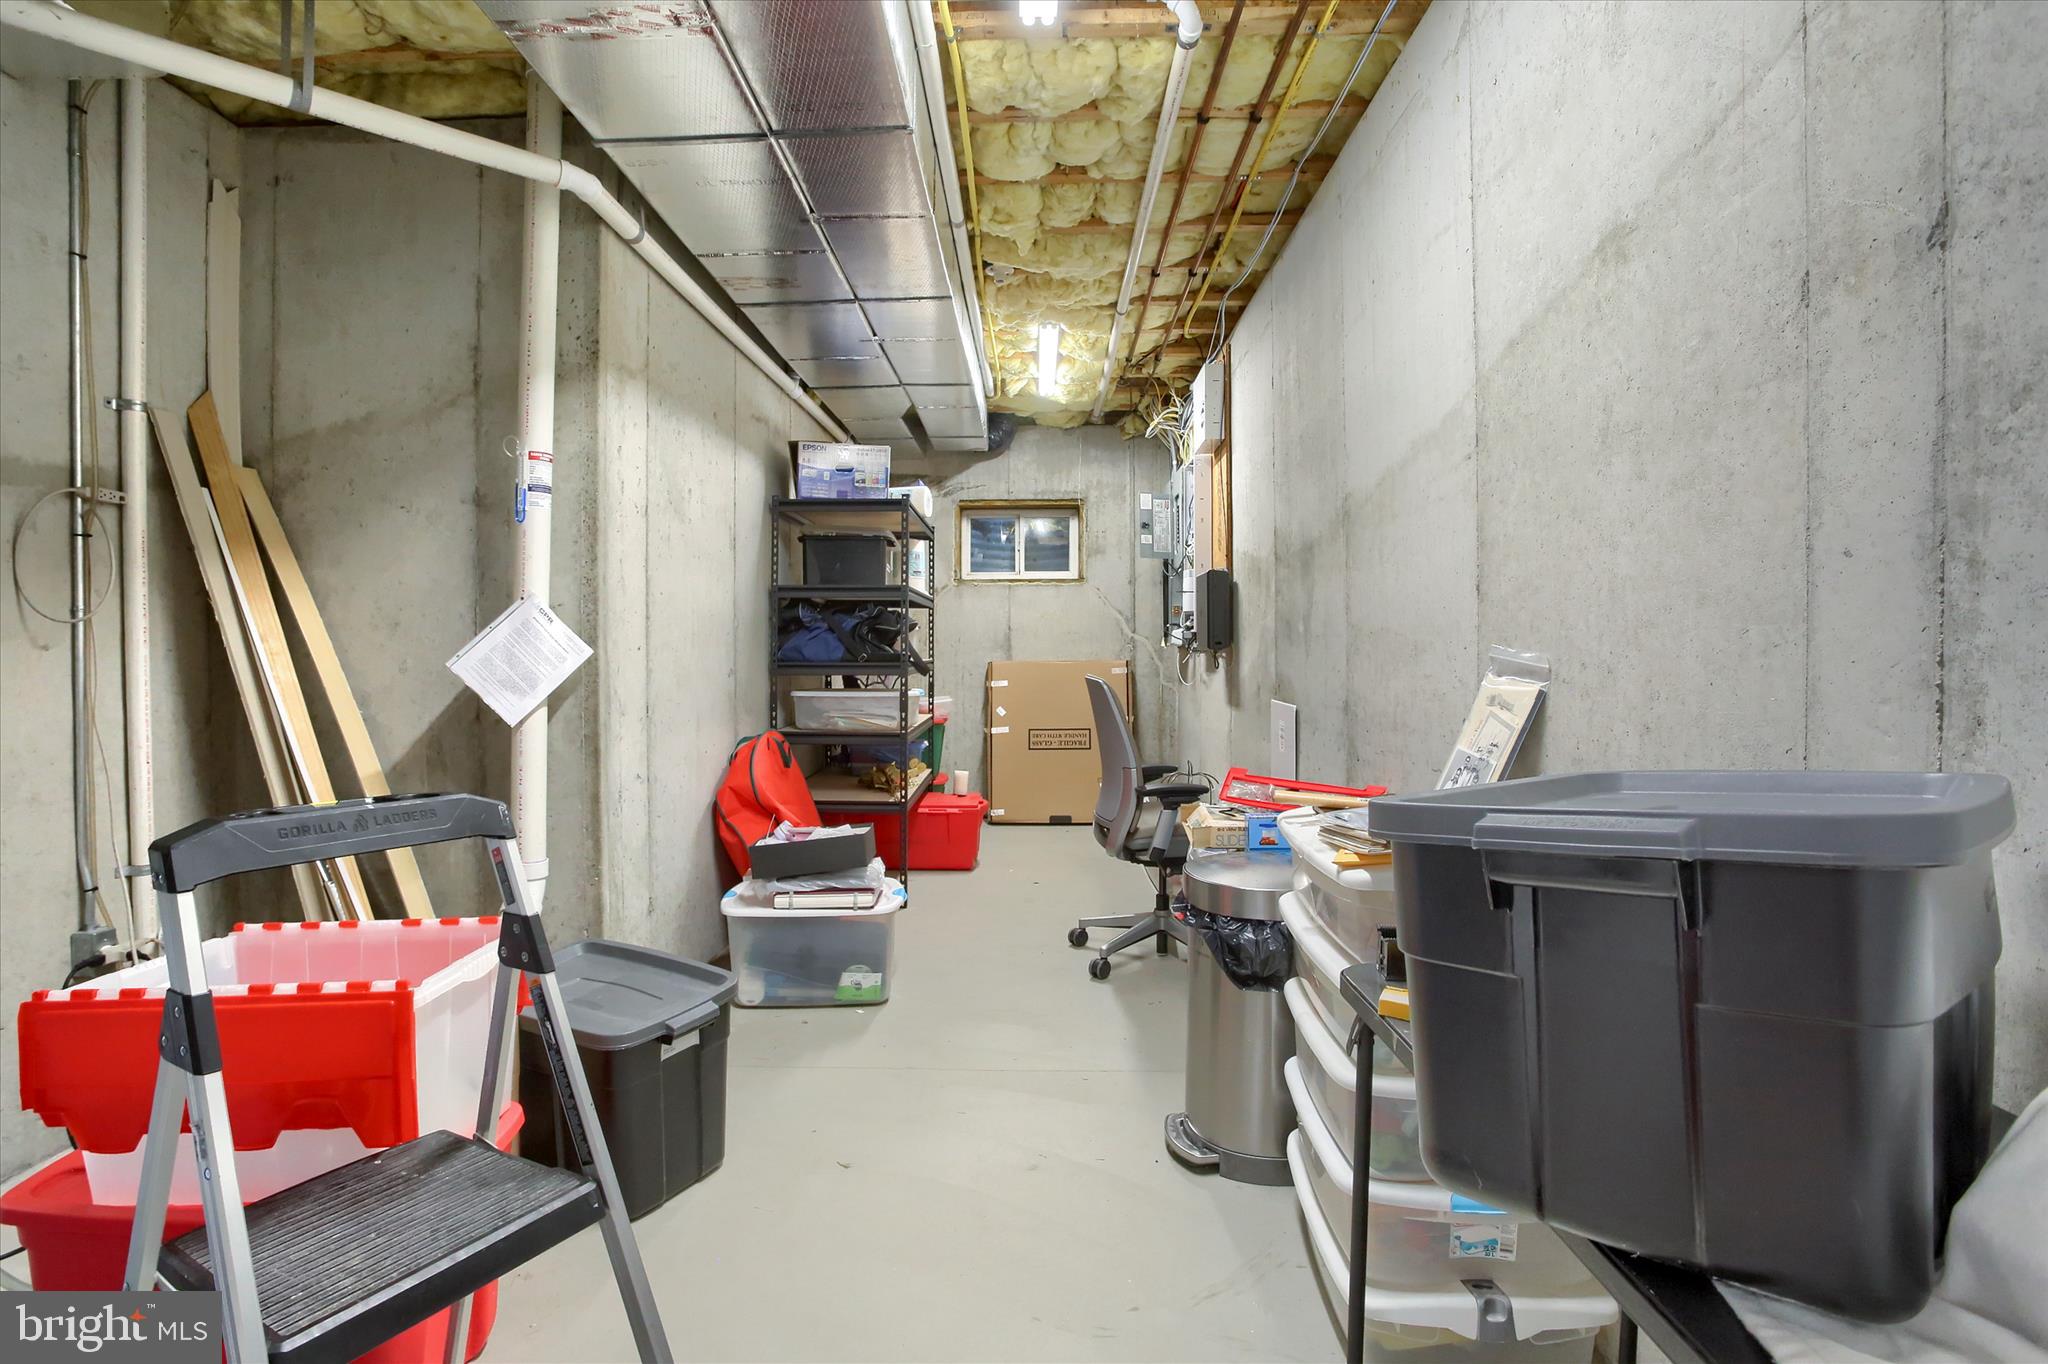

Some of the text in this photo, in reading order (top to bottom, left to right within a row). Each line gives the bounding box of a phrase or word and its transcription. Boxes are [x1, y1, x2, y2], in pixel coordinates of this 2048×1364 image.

[802, 444, 827, 452] EPSON
[277, 809, 438, 840] GORILLA LADDERS
